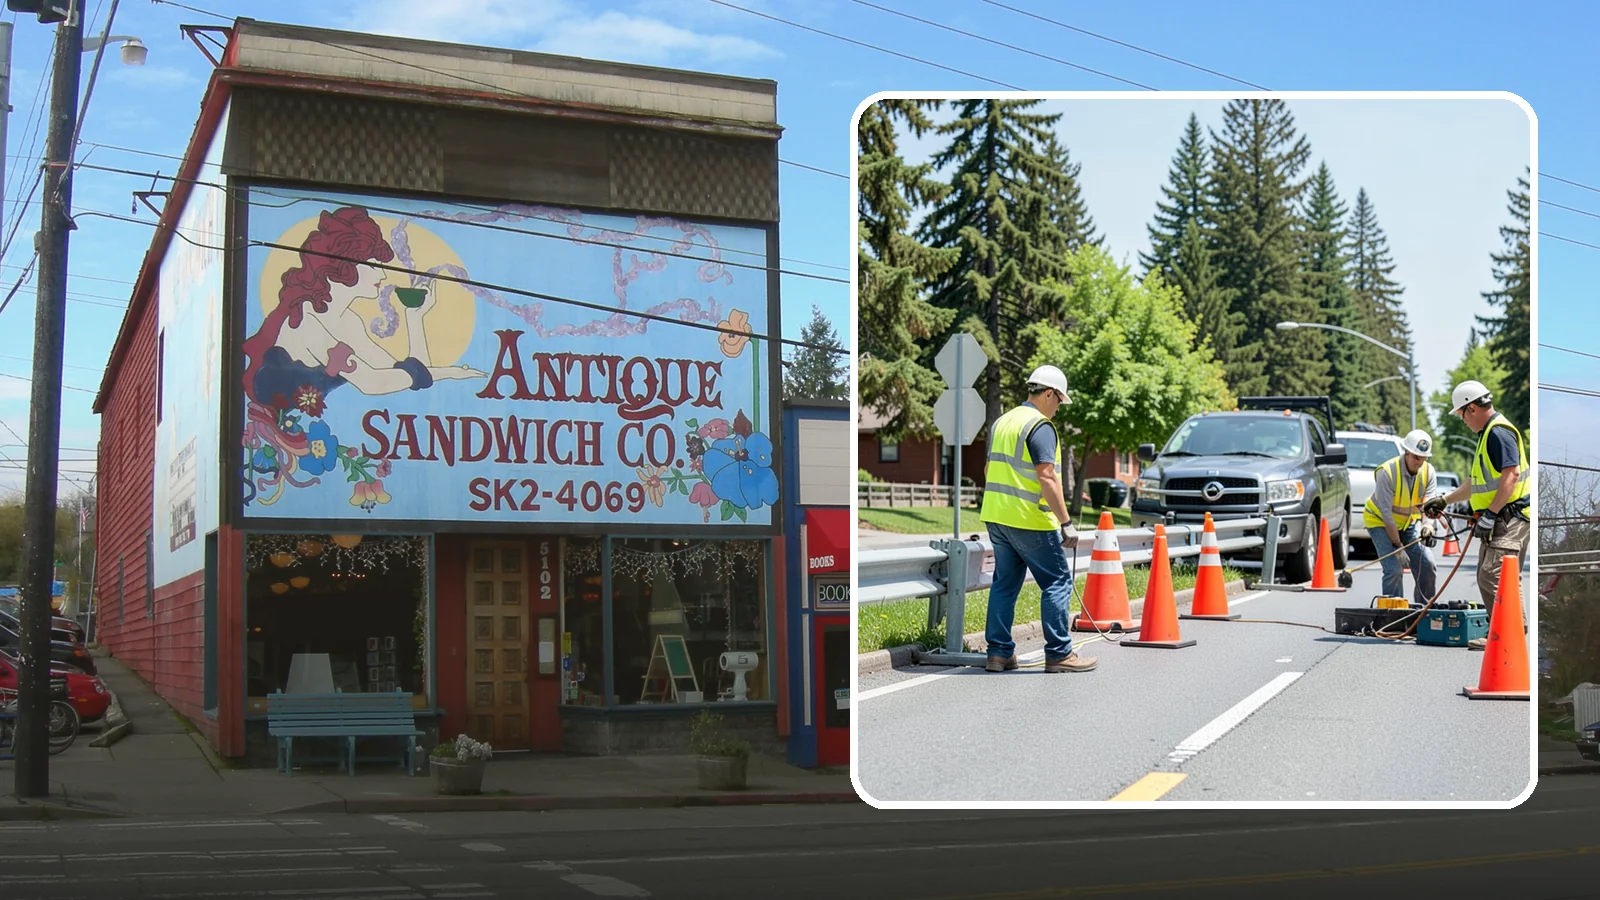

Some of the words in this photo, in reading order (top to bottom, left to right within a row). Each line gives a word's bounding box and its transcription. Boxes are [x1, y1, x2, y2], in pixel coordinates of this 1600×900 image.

[476, 329, 724, 421] ANTIQUE
[361, 408, 604, 467] SANDWICH
[617, 421, 685, 469] CO.
[468, 477, 645, 513] SK2-4069
[540, 541, 551, 600] 5102
[809, 555, 835, 568] BOOKS
